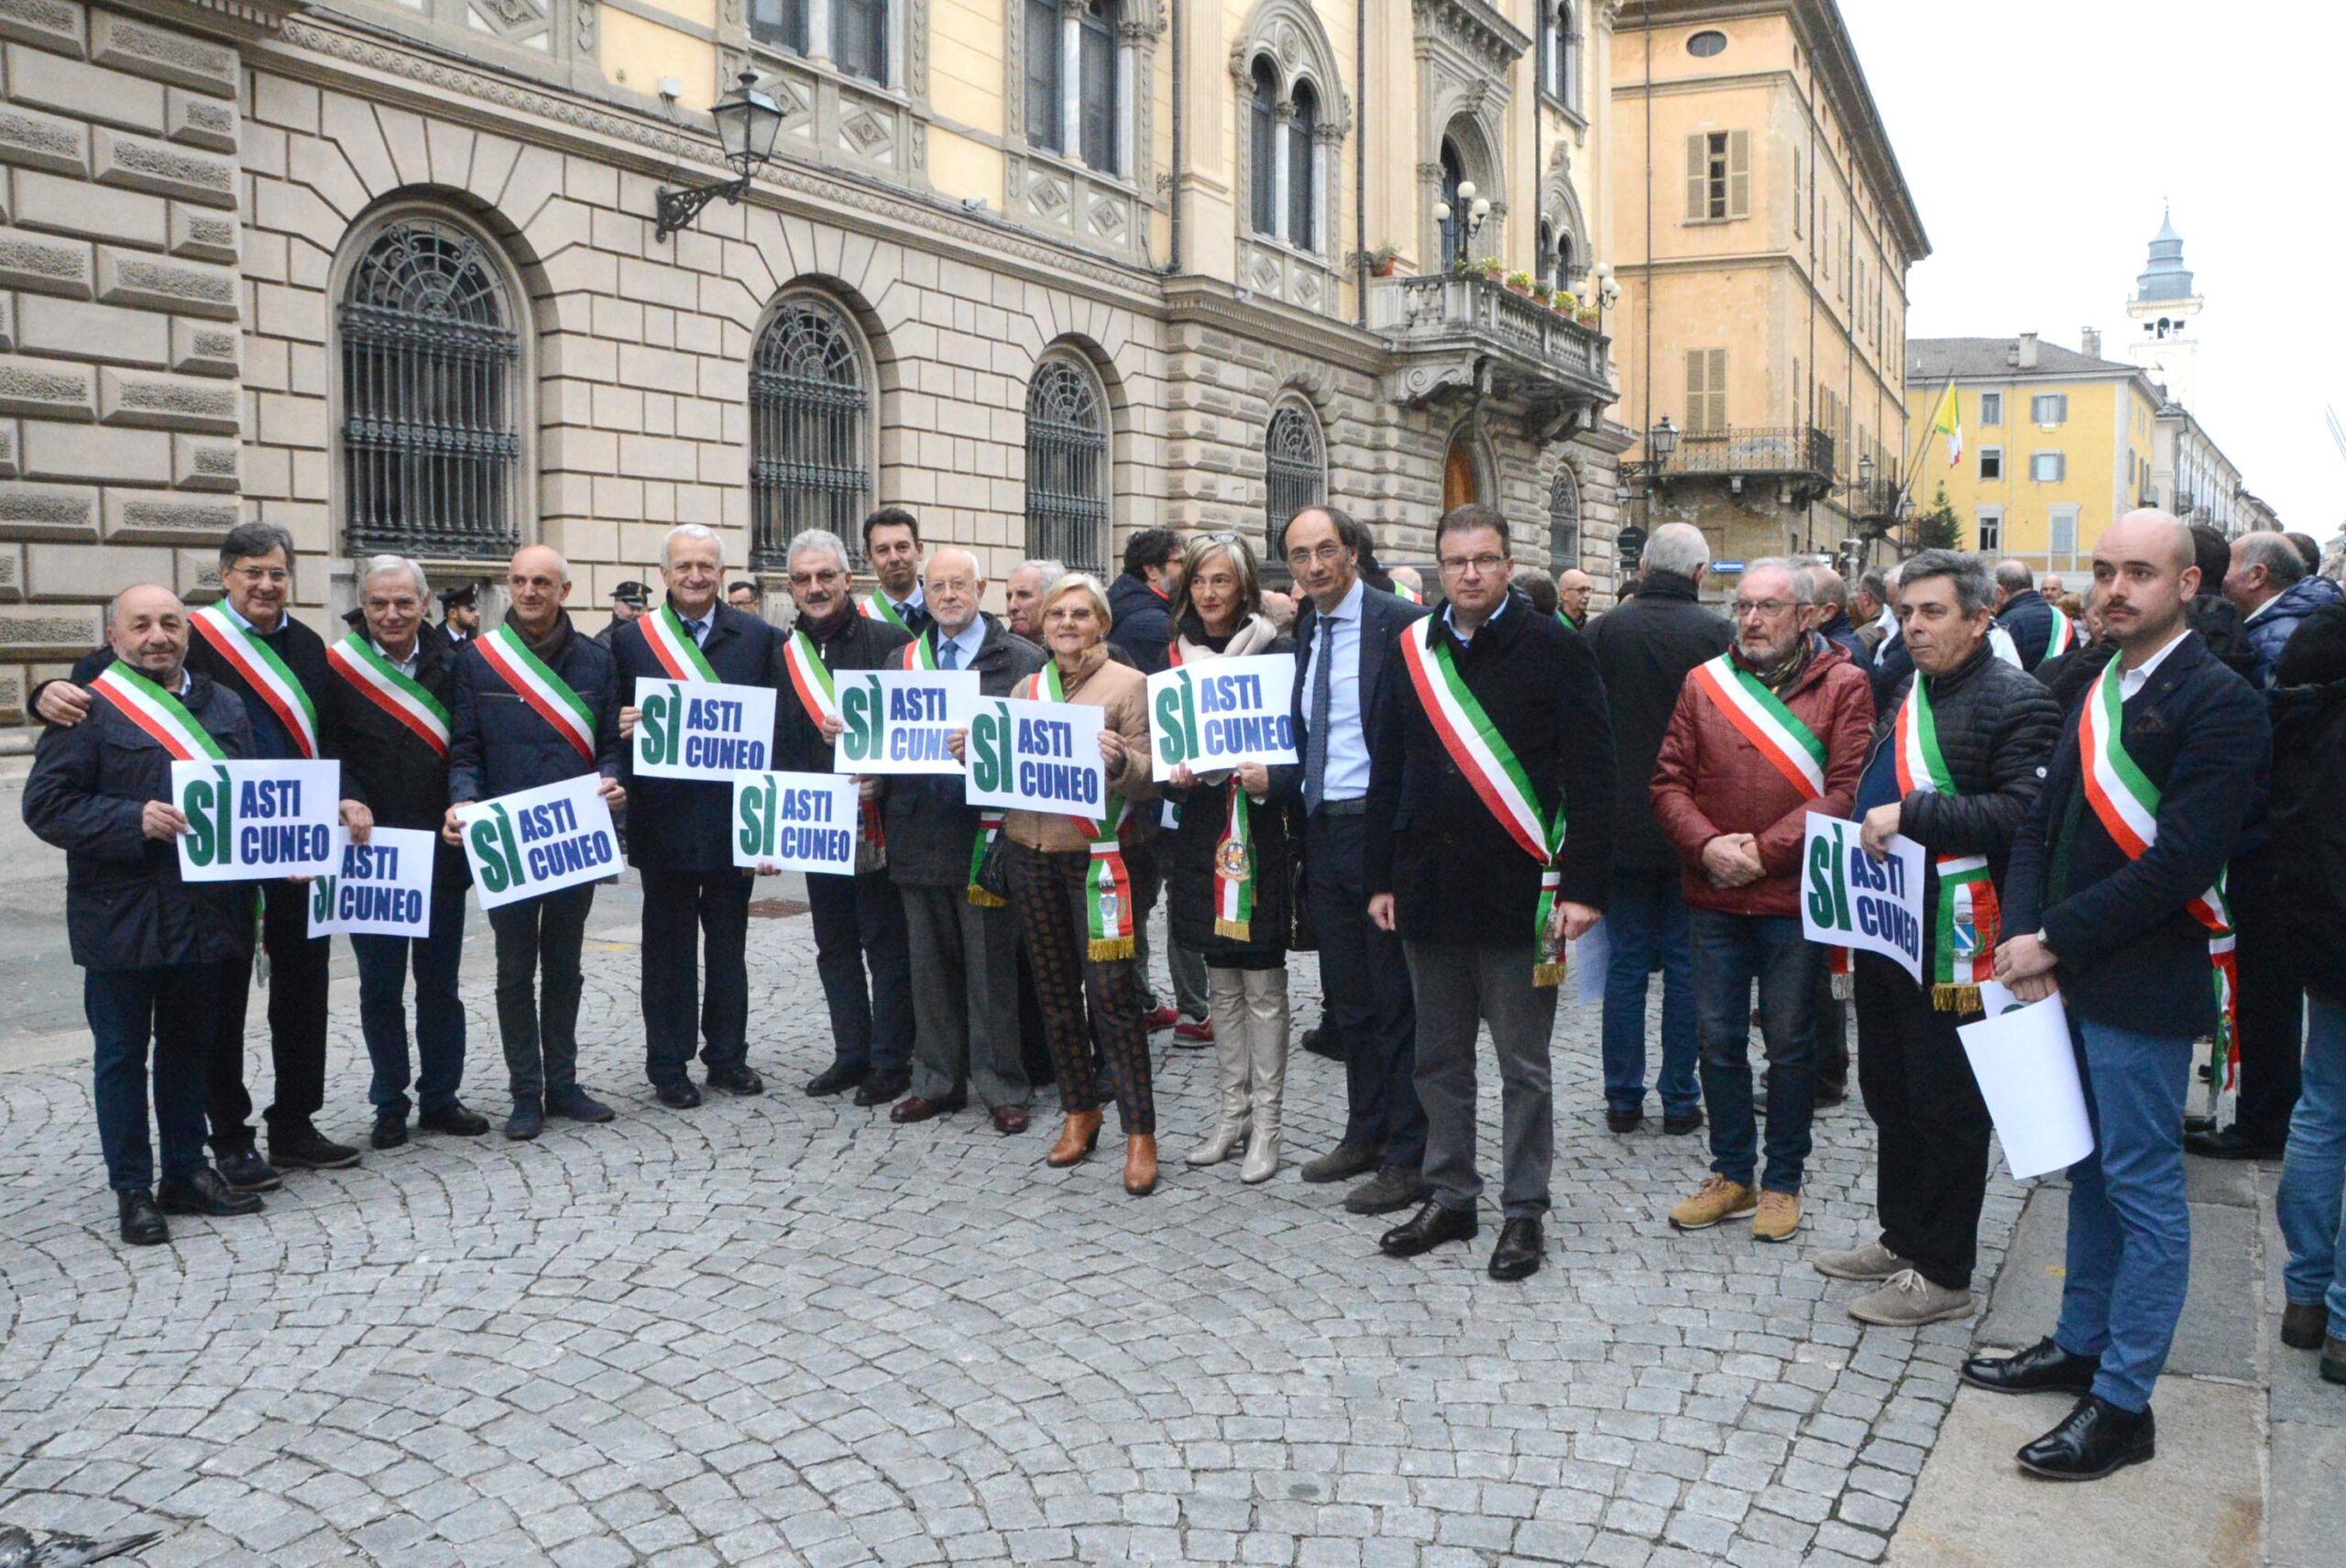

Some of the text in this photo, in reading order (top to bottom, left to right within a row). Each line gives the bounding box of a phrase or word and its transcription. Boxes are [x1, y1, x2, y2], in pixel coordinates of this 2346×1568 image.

[686, 697, 742, 733] ASTI
[890, 687, 947, 721] ASTI
[1200, 674, 1263, 714] ASTI
[641, 683, 682, 765] SÌ
[841, 674, 884, 762] SÌ
[1017, 718, 1072, 758] ASTI
[1156, 668, 1200, 766] SÌ
[1203, 714, 1296, 756] CUNEO
[685, 735, 765, 771] CUNEO
[890, 727, 954, 762] CUNE
[971, 700, 1014, 794] SÌ
[239, 780, 301, 818] ASTI
[1019, 761, 1098, 805] CUNEO
[183, 764, 233, 867] SÌ
[518, 797, 578, 844] ASTI
[740, 774, 777, 856] SÌ
[781, 788, 833, 822] ASTI
[240, 824, 330, 865] CUNEO
[341, 844, 399, 881] ASTI
[470, 802, 527, 894] SÌ
[528, 829, 613, 882] CUNEO
[780, 826, 850, 862] CUNEO
[1807, 821, 1853, 932] SÌ
[1850, 846, 1905, 900] ASTI
[339, 884, 422, 925] CUNEO
[1856, 894, 1919, 963] CUNEO
